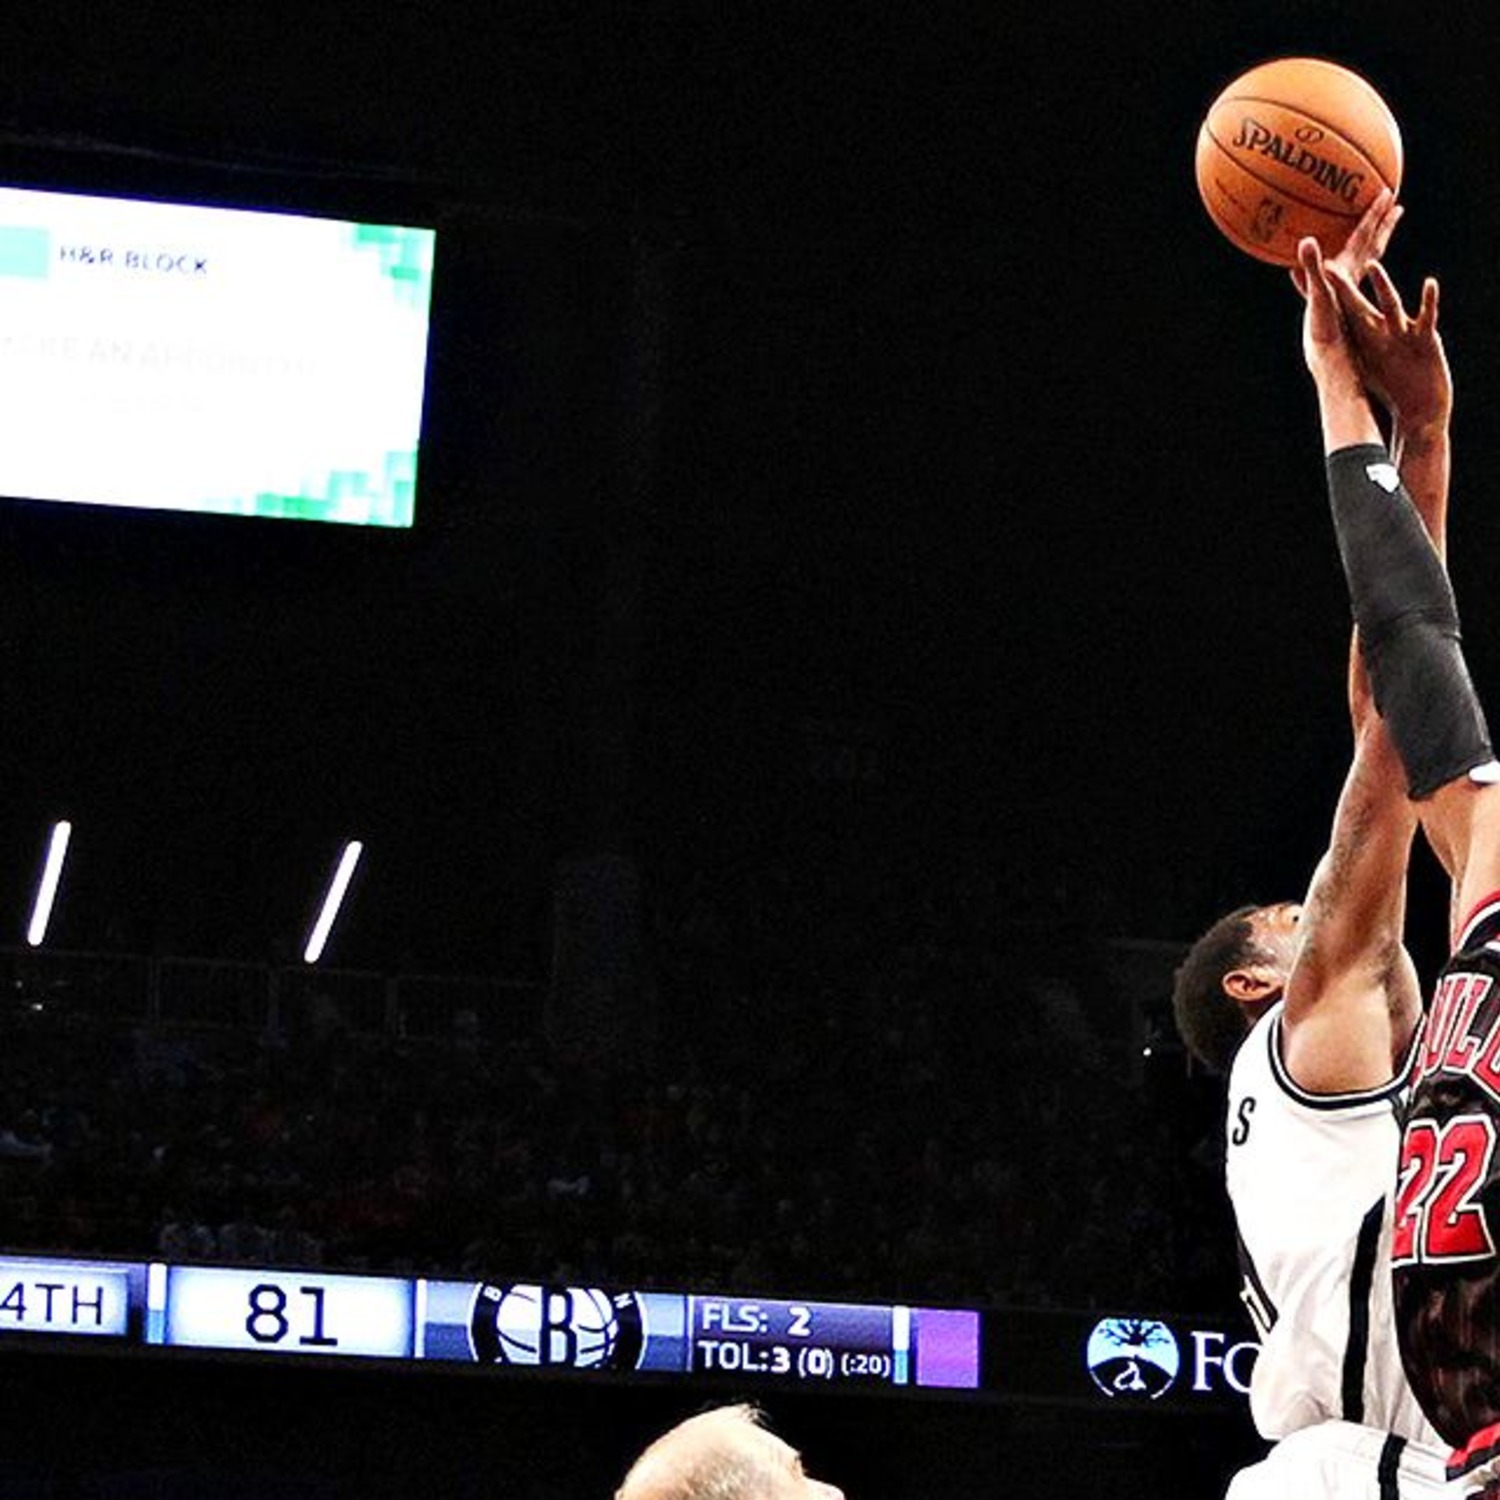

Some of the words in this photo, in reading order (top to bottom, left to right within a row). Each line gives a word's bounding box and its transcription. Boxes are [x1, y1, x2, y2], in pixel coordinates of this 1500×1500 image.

[1233, 117, 1366, 203] SPALDING
[60, 246, 114, 265] H&R
[125, 250, 208, 275] BLOCK
[1390, 1113, 1497, 1264] 22
[0, 1282, 104, 1326] 4TH
[244, 1283, 338, 1347] 81
[702, 1303, 768, 1333] FLS:
[787, 1306, 812, 1337] 2
[841, 1353, 890, 1377] (:20)
